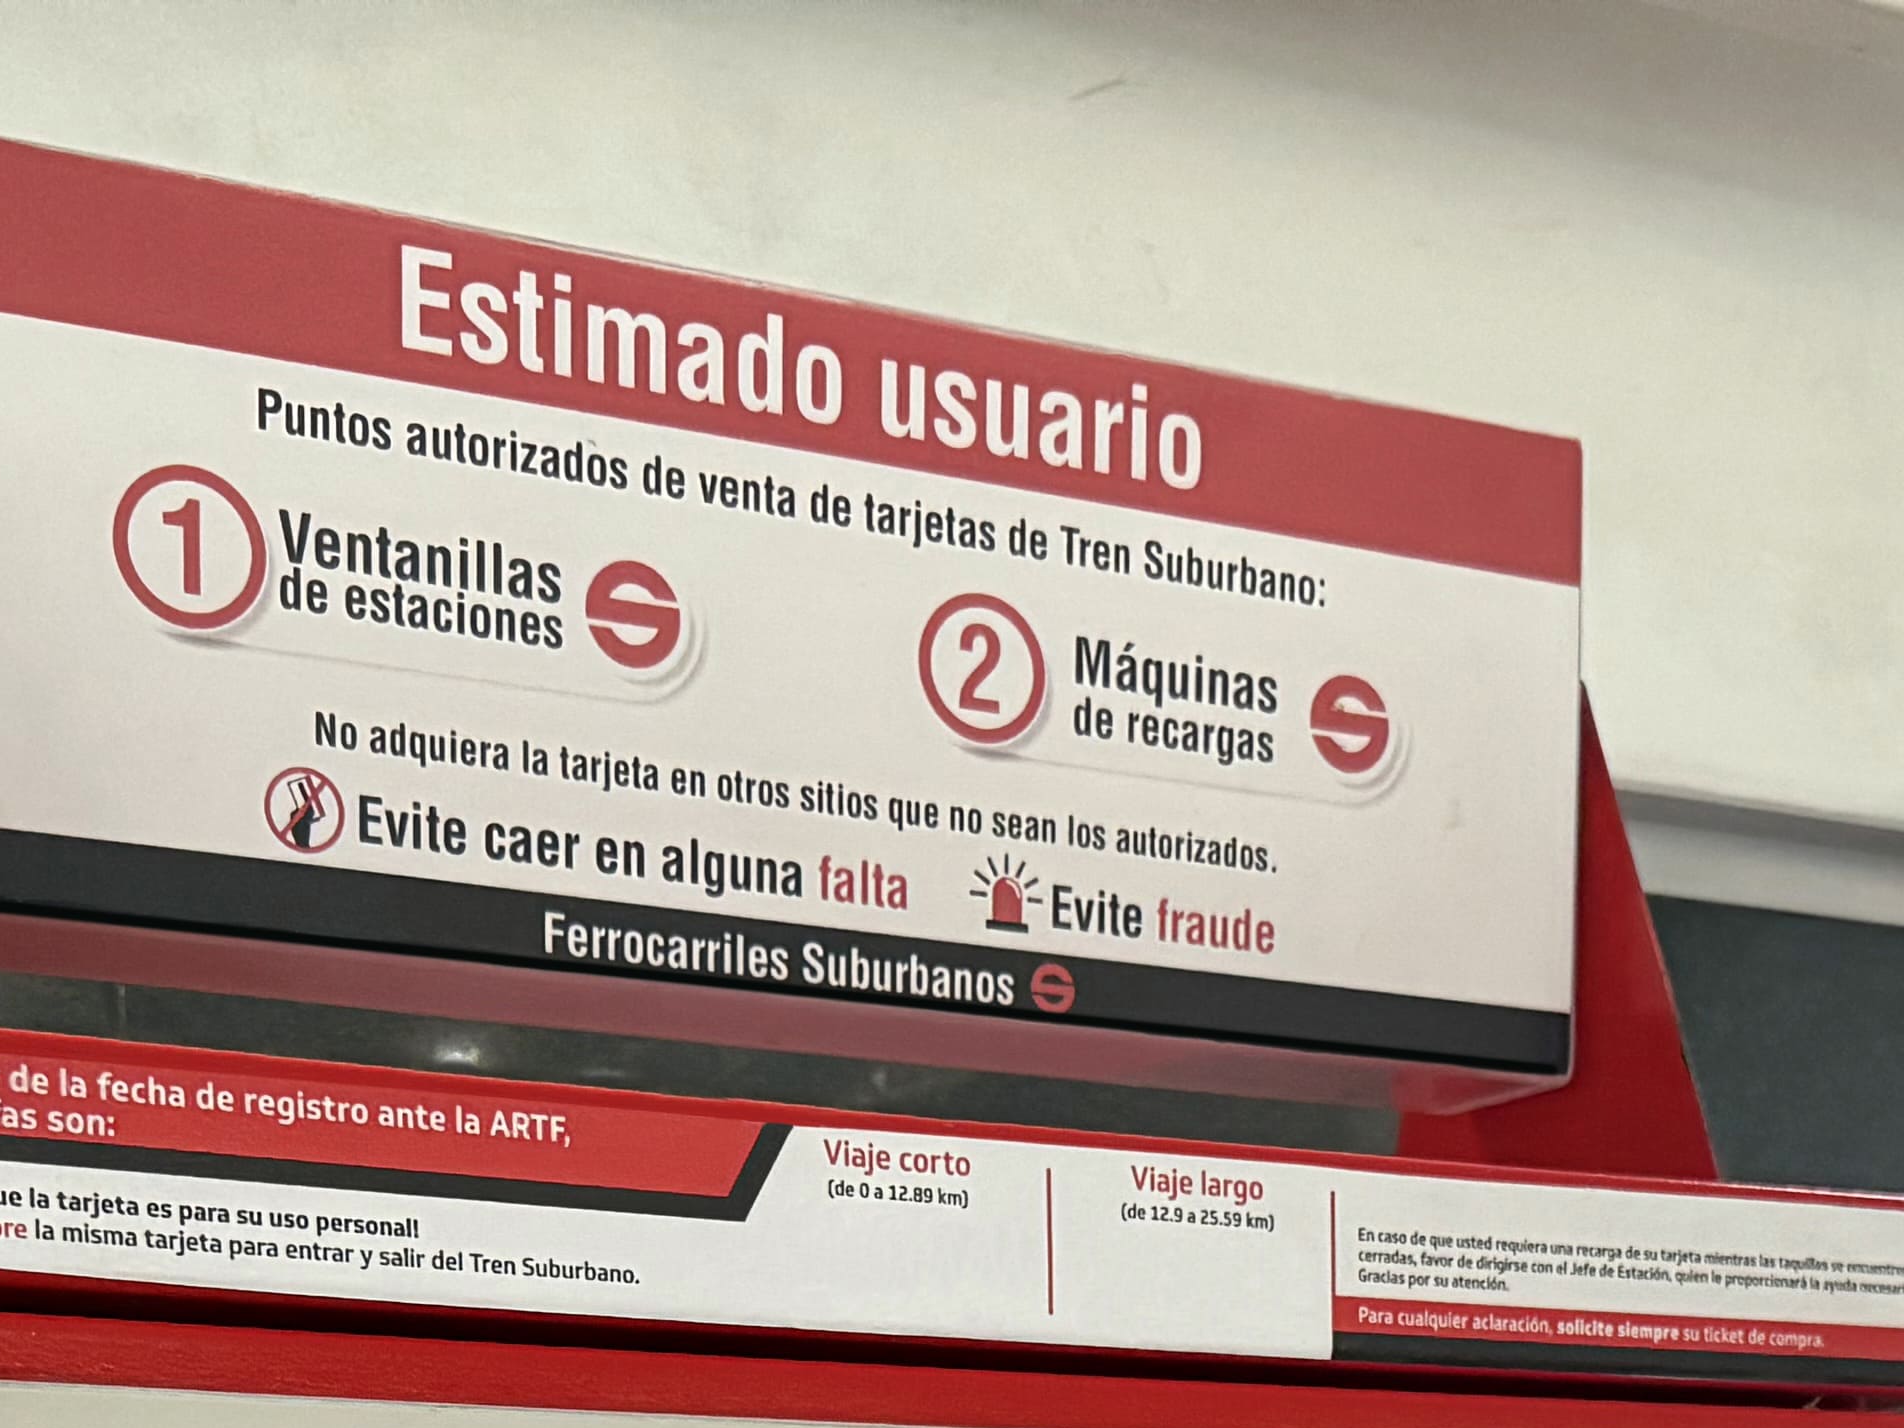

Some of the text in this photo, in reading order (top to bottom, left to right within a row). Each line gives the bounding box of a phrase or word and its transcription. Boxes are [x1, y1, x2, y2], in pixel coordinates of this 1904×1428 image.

[402, 245, 1201, 489] Estimado usuario
[258, 388, 1324, 607] Puntos autorizados de venta de tarjetas de Tren Suburbano:
[160, 498, 201, 597] 1
[279, 509, 560, 603] Ventanillas
[280, 573, 562, 649] de estaciones
[956, 624, 1001, 715] 2
[1076, 636, 1277, 713] Máquinas
[1074, 700, 1273, 765] de recargas
[316, 712, 1276, 873] No adquiera la tarjeta en otros sitios que no sean los autorizados.
[359, 795, 907, 909] Evite caer en alguna falta
[1052, 884, 1274, 953] Evite fraude
[545, 912, 1014, 1005] Ferrocarriles Suburbanos
[10, 1064, 48, 1094] de
[60, 1068, 86, 1098] la
[97, 1072, 185, 1107] fecha
[197, 1082, 233, 1111] de
[245, 1091, 368, 1125] registro
[379, 1105, 445, 1131] ante
[456, 1106, 480, 1134] la
[491, 1111, 569, 1147] ARTF,
[48, 1111, 116, 1136] son:
[824, 1139, 970, 1176] Viaje corto
[829, 1180, 968, 1208] (de 0 a 12.89 km)
[1131, 1165, 1263, 1206] Viaje largo
[30, 1188, 49, 1208] la
[57, 1192, 139, 1218] tarjeta
[147, 1203, 171, 1218] es
[179, 1205, 229, 1225] para
[237, 1210, 262, 1225] su
[269, 1212, 308, 1229] uso
[317, 1216, 418, 1238] personal!
[1122, 1203, 1274, 1232] (de 12.9 a 25.59 km)
[35, 1219, 54, 1240] la
[63, 1223, 137, 1246] misma
[144, 1230, 222, 1256] tarjeta
[230, 1240, 278, 1260] para
[286, 1243, 354, 1262] entrar
[360, 1250, 372, 1269] y
[380, 1248, 425, 1268] salir
[432, 1250, 463, 1271] del
[469, 1253, 516, 1275] Tren
[522, 1258, 639, 1284] Suburbano.
